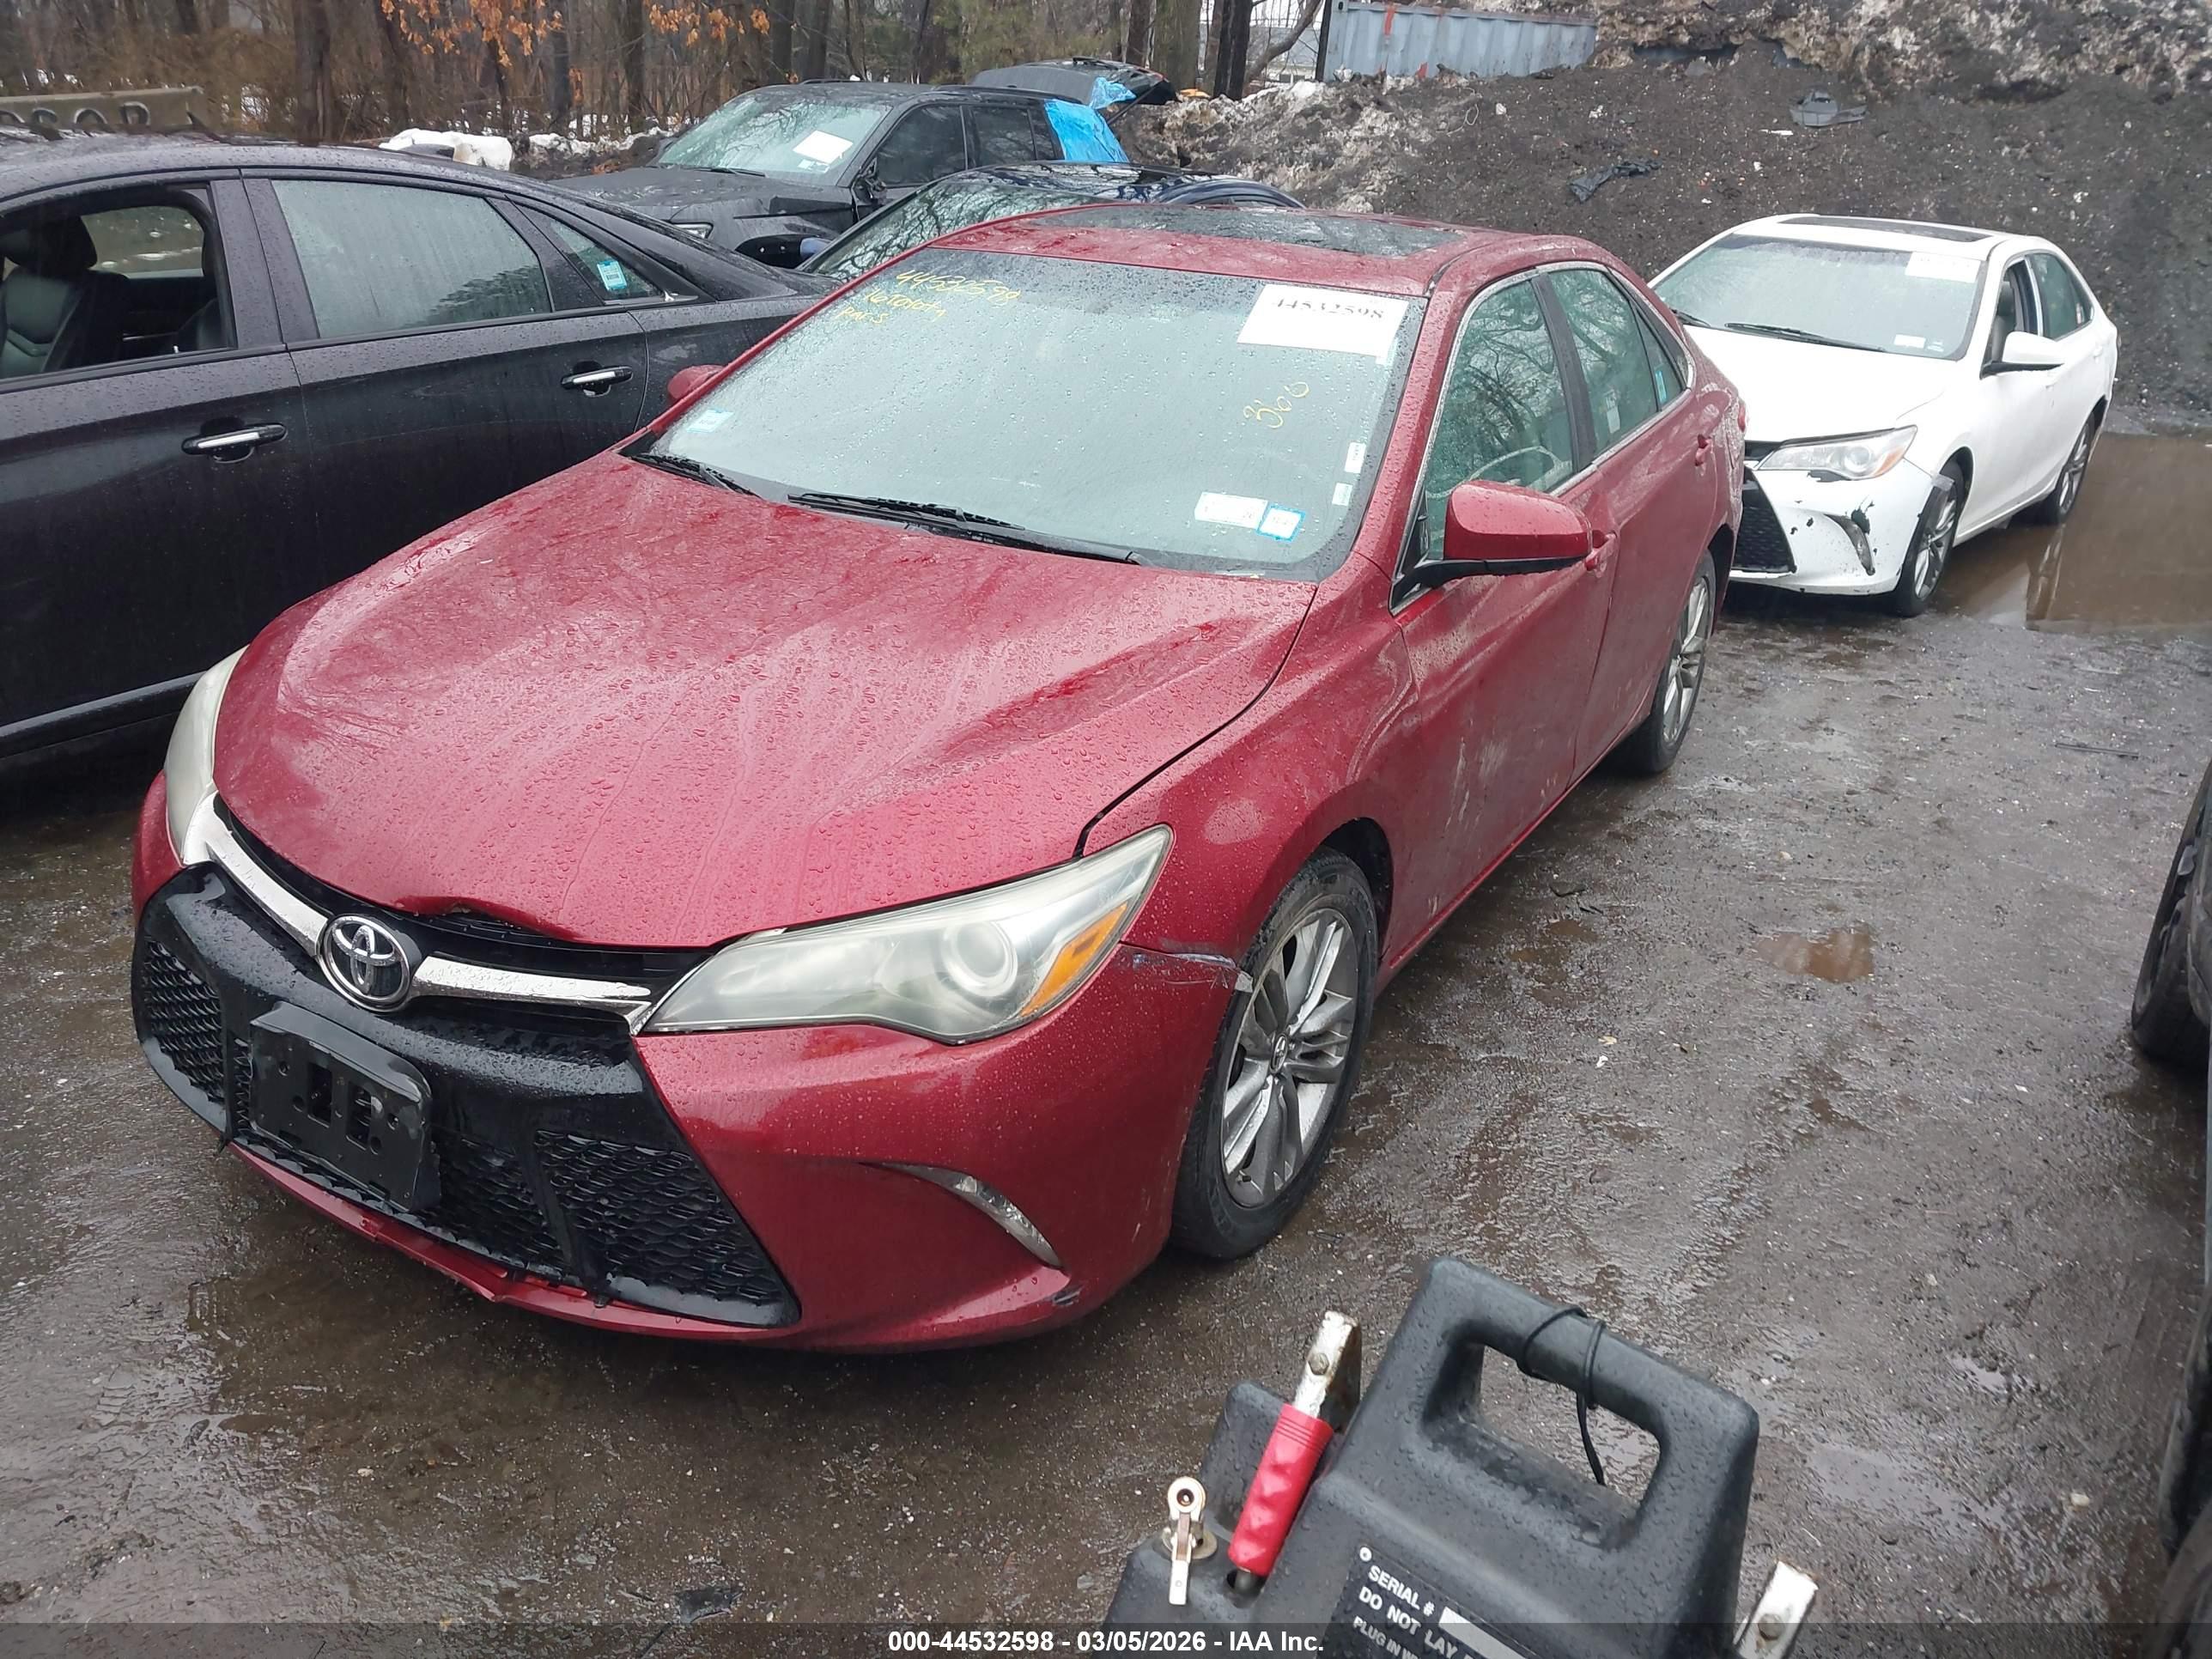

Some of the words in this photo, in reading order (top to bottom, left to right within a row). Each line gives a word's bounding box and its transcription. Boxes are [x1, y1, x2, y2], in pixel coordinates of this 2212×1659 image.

[1368, 1565, 1420, 1610] SERIAL
[1423, 1601, 1435, 1617] #
[1353, 1616, 1387, 1647] PLUG
[1386, 1638, 1401, 1656] IN
[1358, 1586, 1383, 1610] DO
[1387, 1604, 1422, 1635] NOT
[1424, 1629, 1458, 1659] LAY
